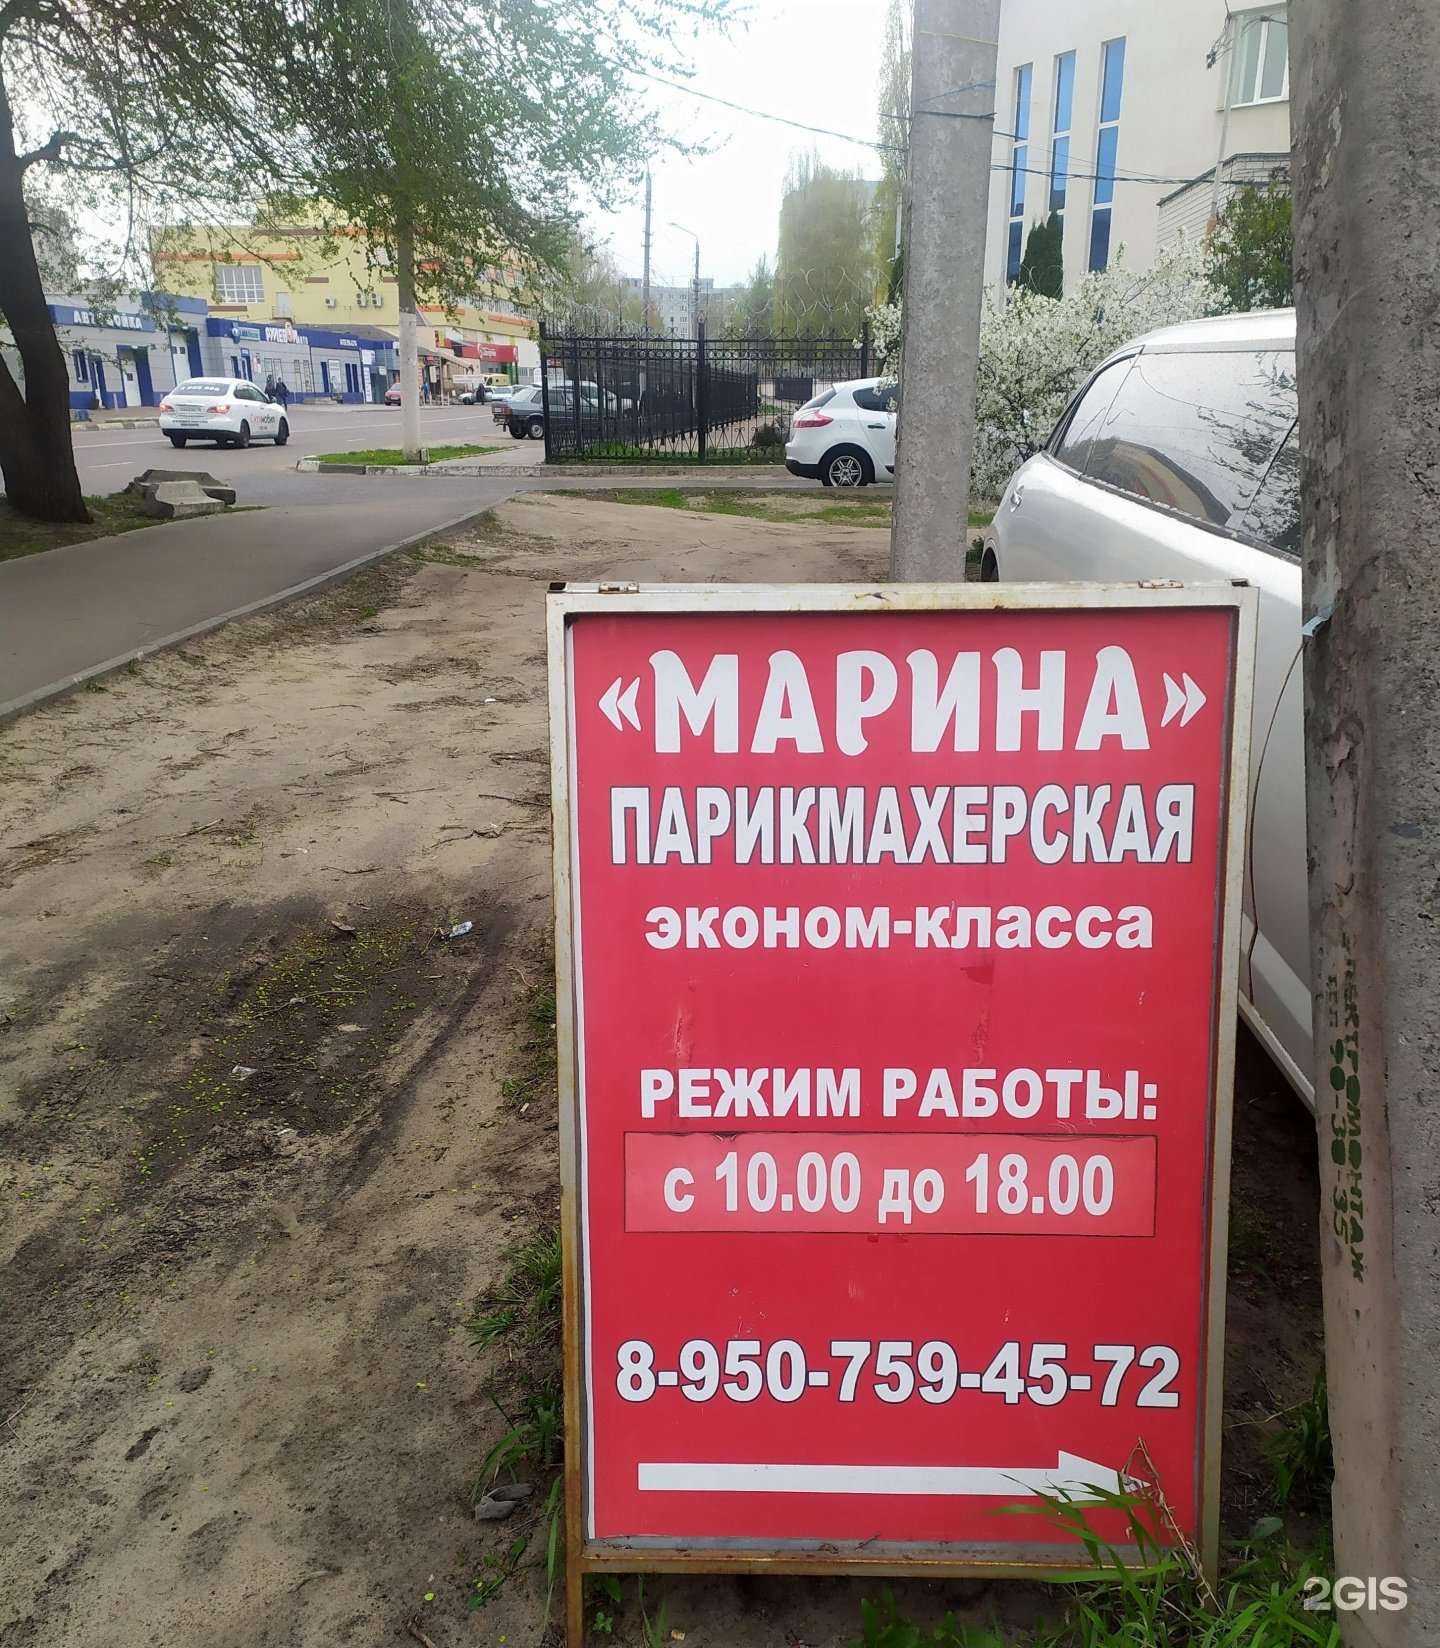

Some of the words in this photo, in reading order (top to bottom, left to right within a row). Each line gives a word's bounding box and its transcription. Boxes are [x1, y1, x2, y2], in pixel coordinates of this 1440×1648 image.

[73, 310, 143, 329] АВТОЙКА
[599, 646, 1206, 756] «МАРИНА»
[611, 784, 1195, 864] ПАРИКМАХЕРСКАЯ
[646, 905, 1153, 950] эконом-класса
[641, 1069, 861, 1118] РЕЖИМ
[883, 1069, 1157, 1120] РАБОТЫ:
[1330, 1038, 1348, 1244] 90-30-35
[663, 1167, 695, 1213] с
[715, 1151, 861, 1213] 10.00
[878, 1168, 945, 1224] до
[965, 1153, 1114, 1216] 18.00
[616, 1340, 1180, 1407] 8-950-759-45-72
